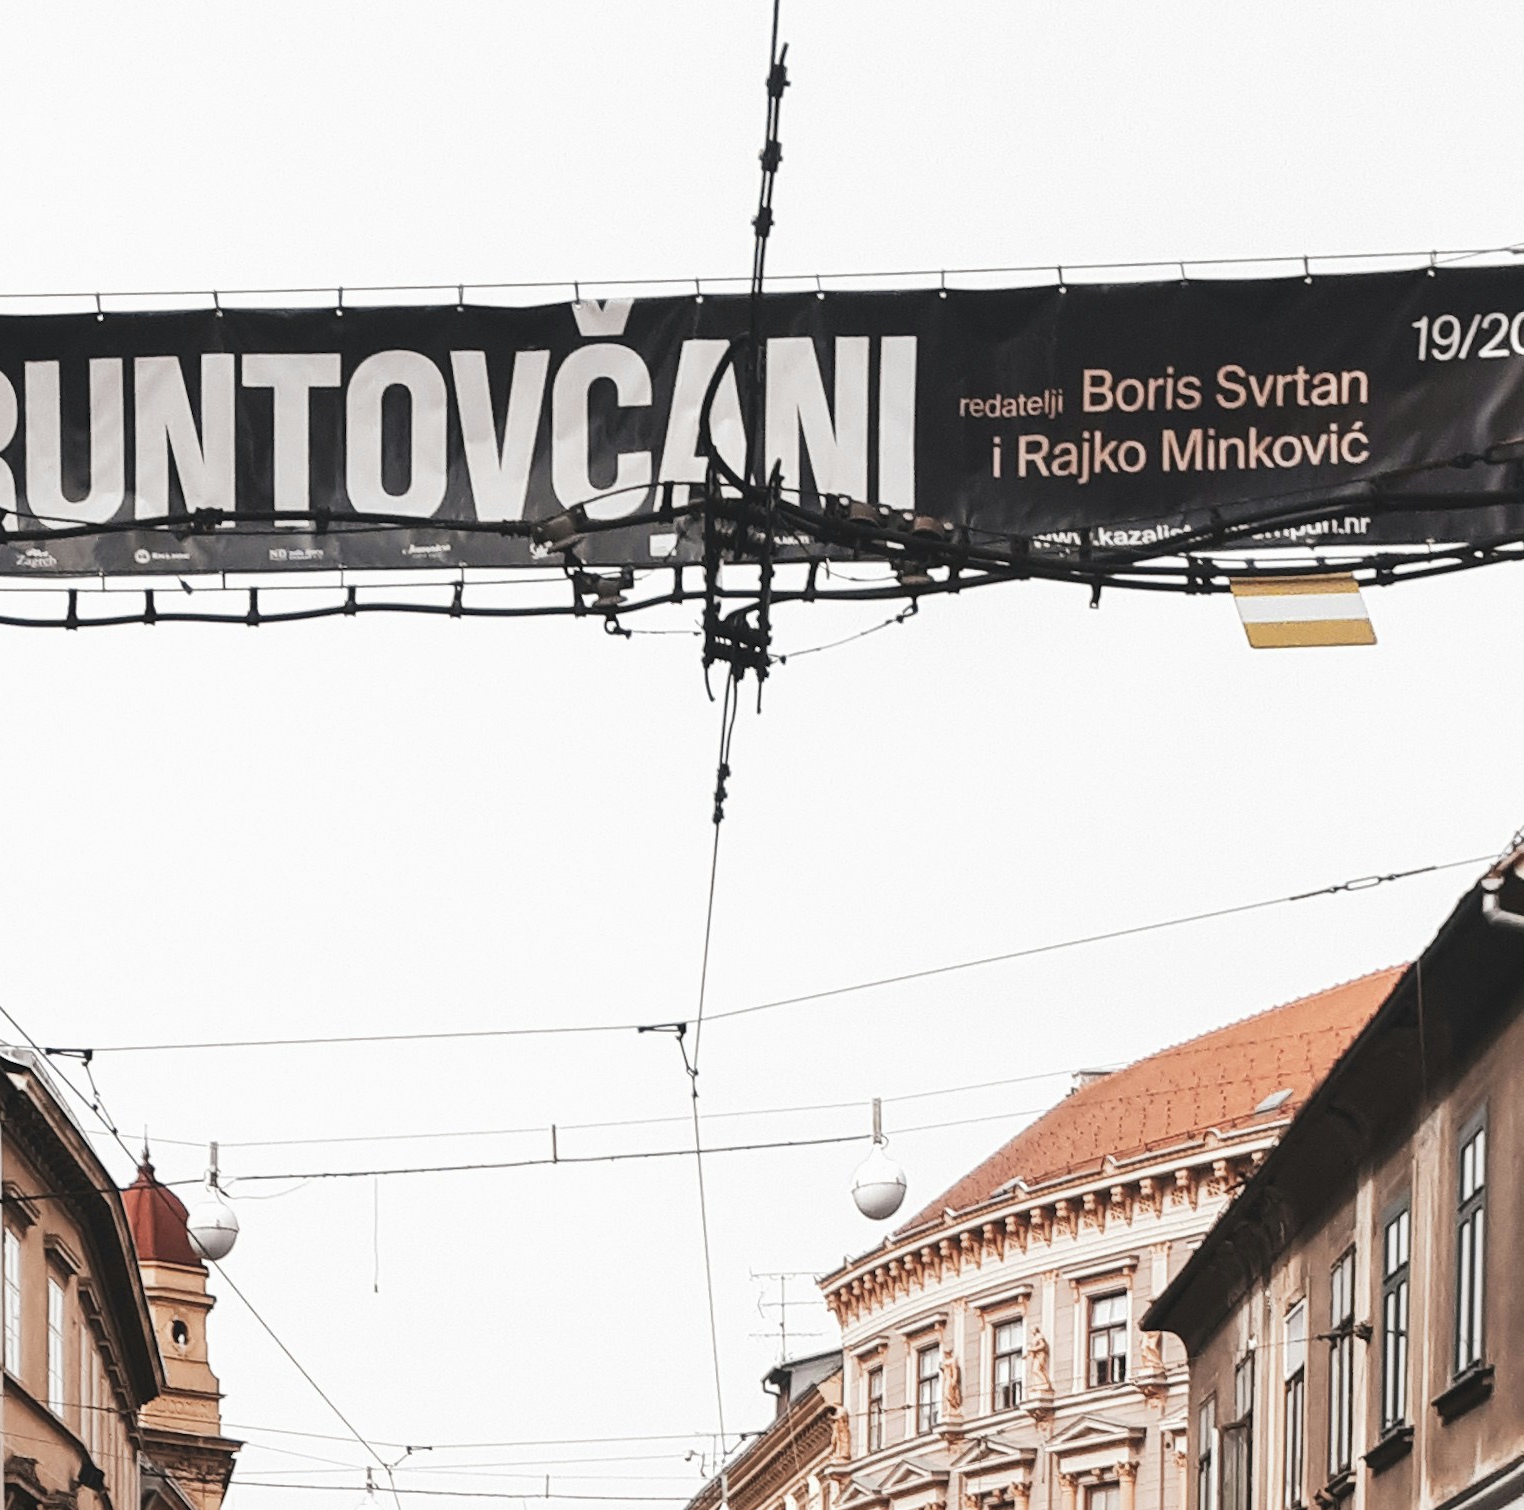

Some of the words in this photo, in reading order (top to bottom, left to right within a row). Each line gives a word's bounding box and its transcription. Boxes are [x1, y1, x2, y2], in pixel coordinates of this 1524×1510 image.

[958, 389, 1064, 420] redatelji
[1082, 366, 1202, 415] Boris
[1215, 363, 1370, 410] Svrtan
[991, 435, 1002, 478] i
[1017, 434, 1148, 485] Rajko
[1161, 420, 1371, 474] Minković
